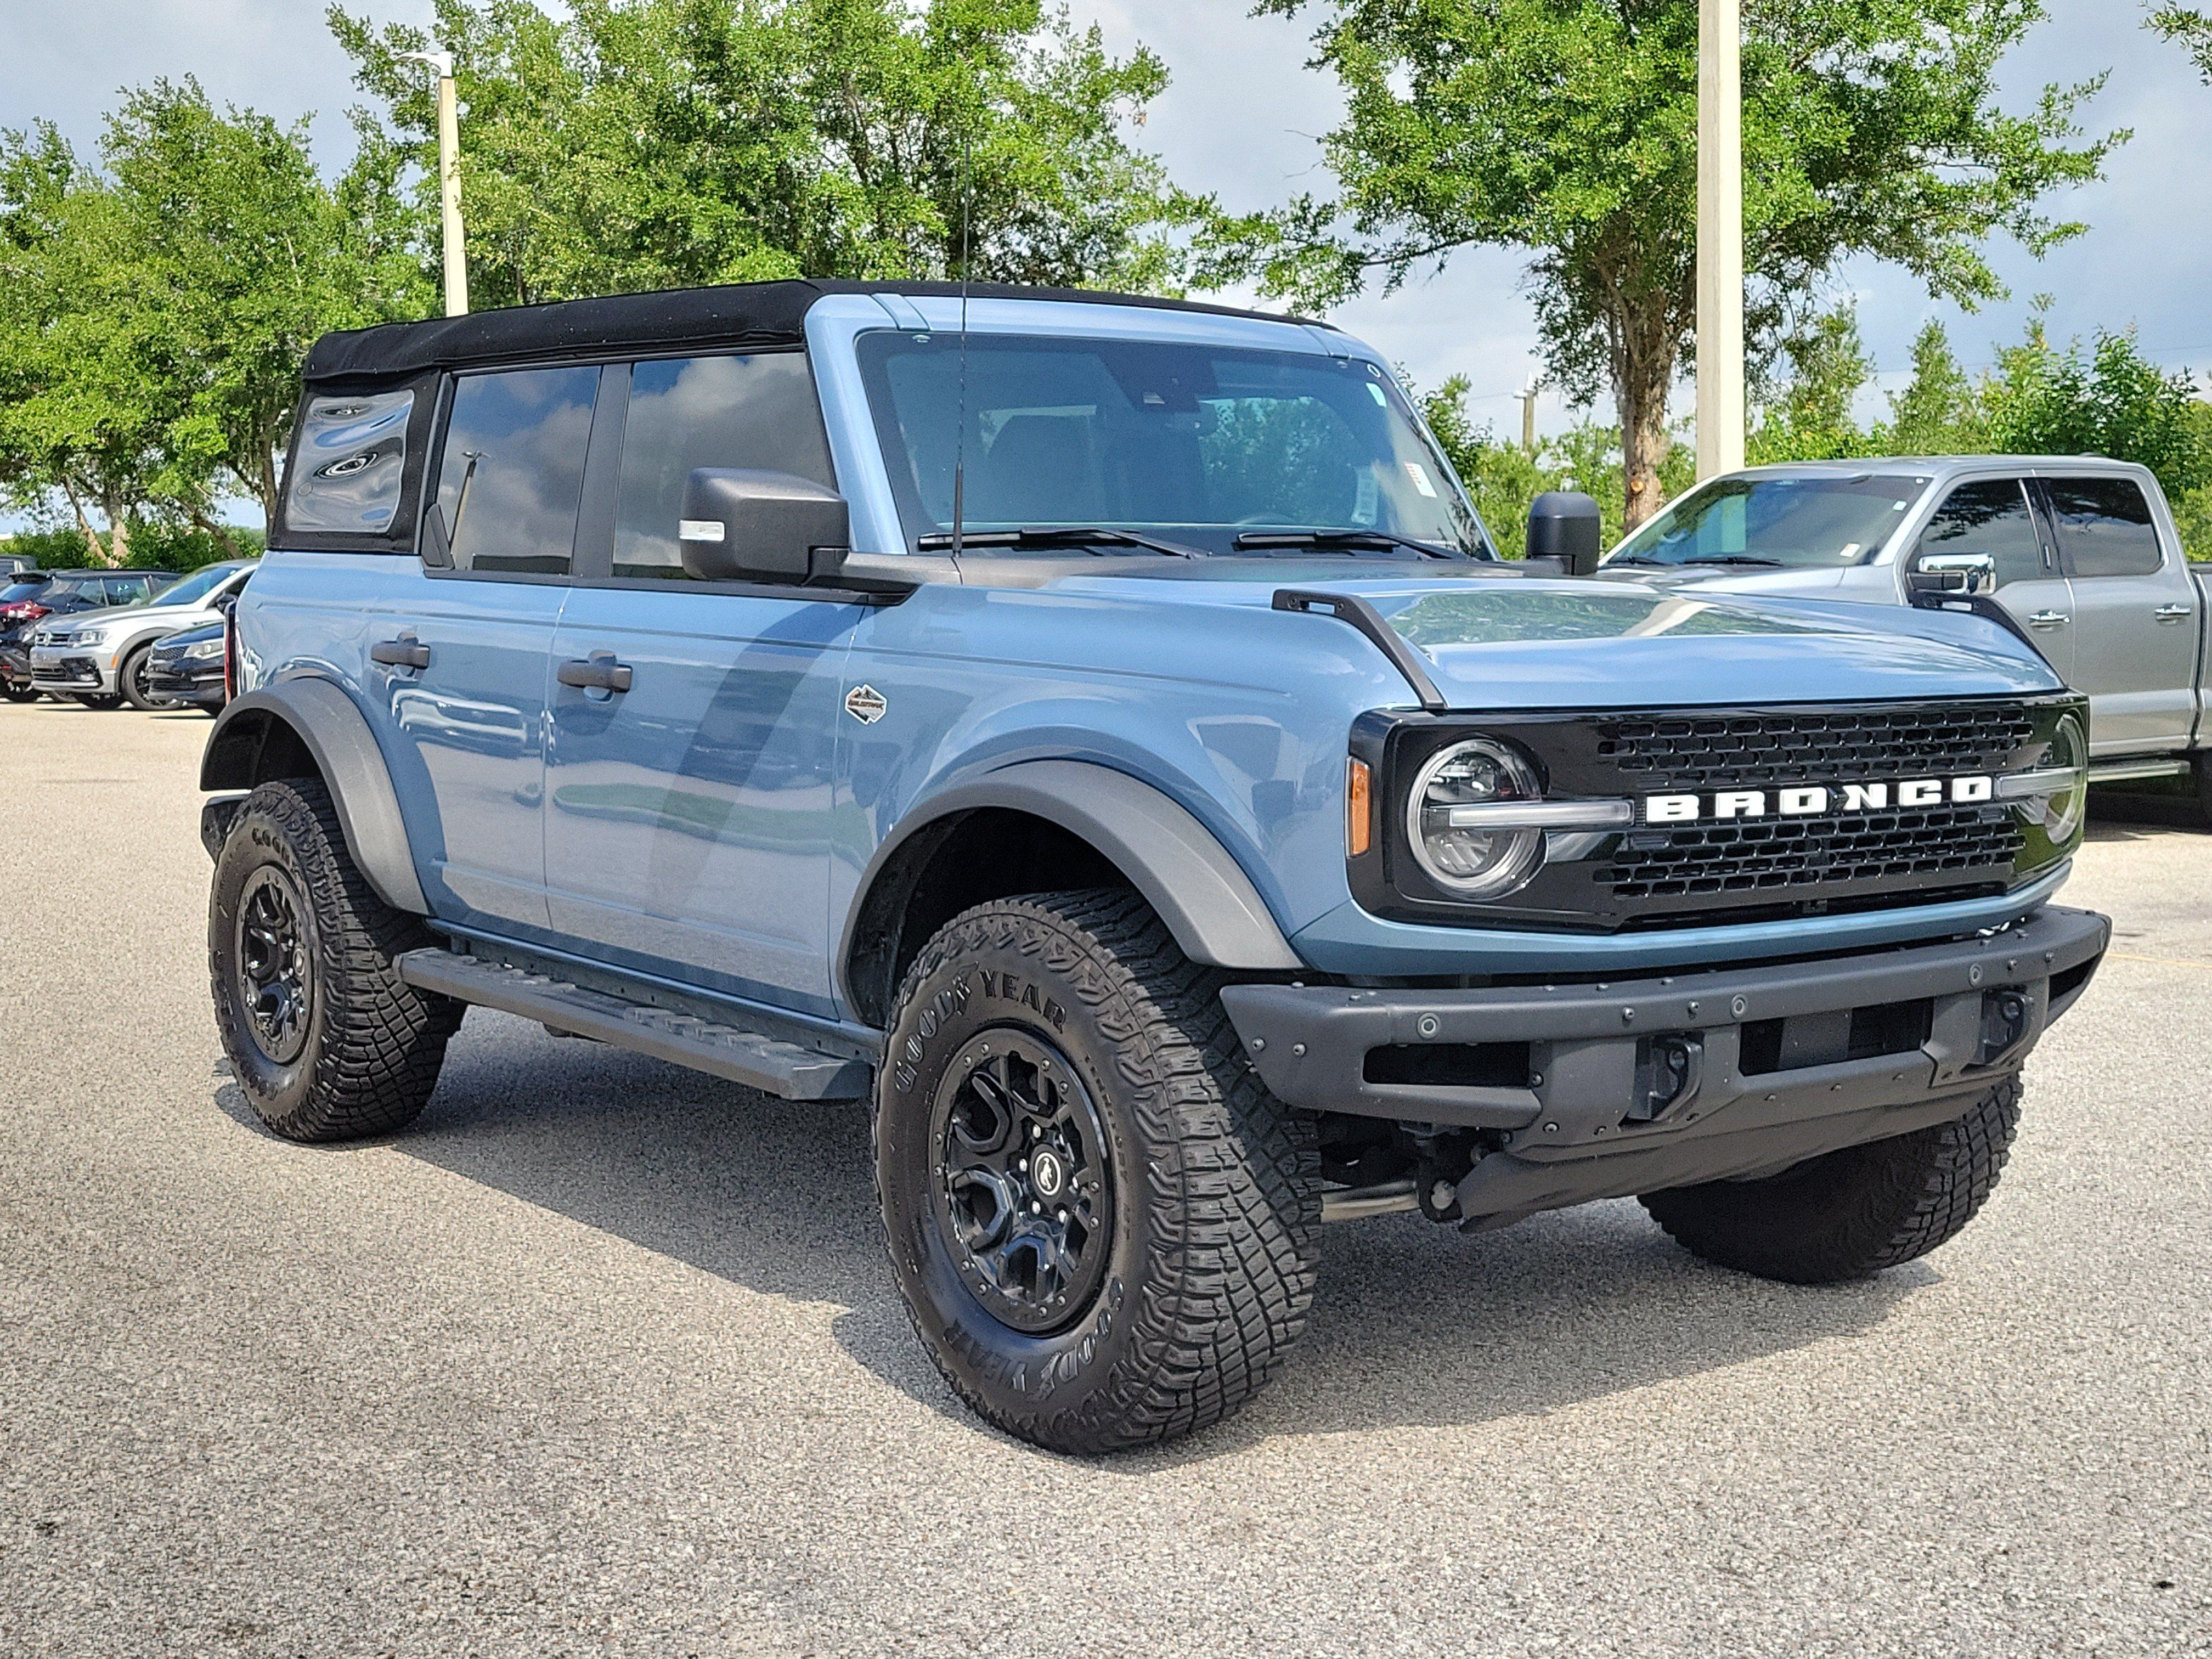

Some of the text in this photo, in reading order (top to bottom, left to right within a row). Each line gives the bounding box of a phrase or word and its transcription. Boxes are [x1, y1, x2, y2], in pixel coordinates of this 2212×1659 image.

[1646, 776, 1993, 822] BRONCO
[895, 970, 1066, 1093] GOOD YEAR
